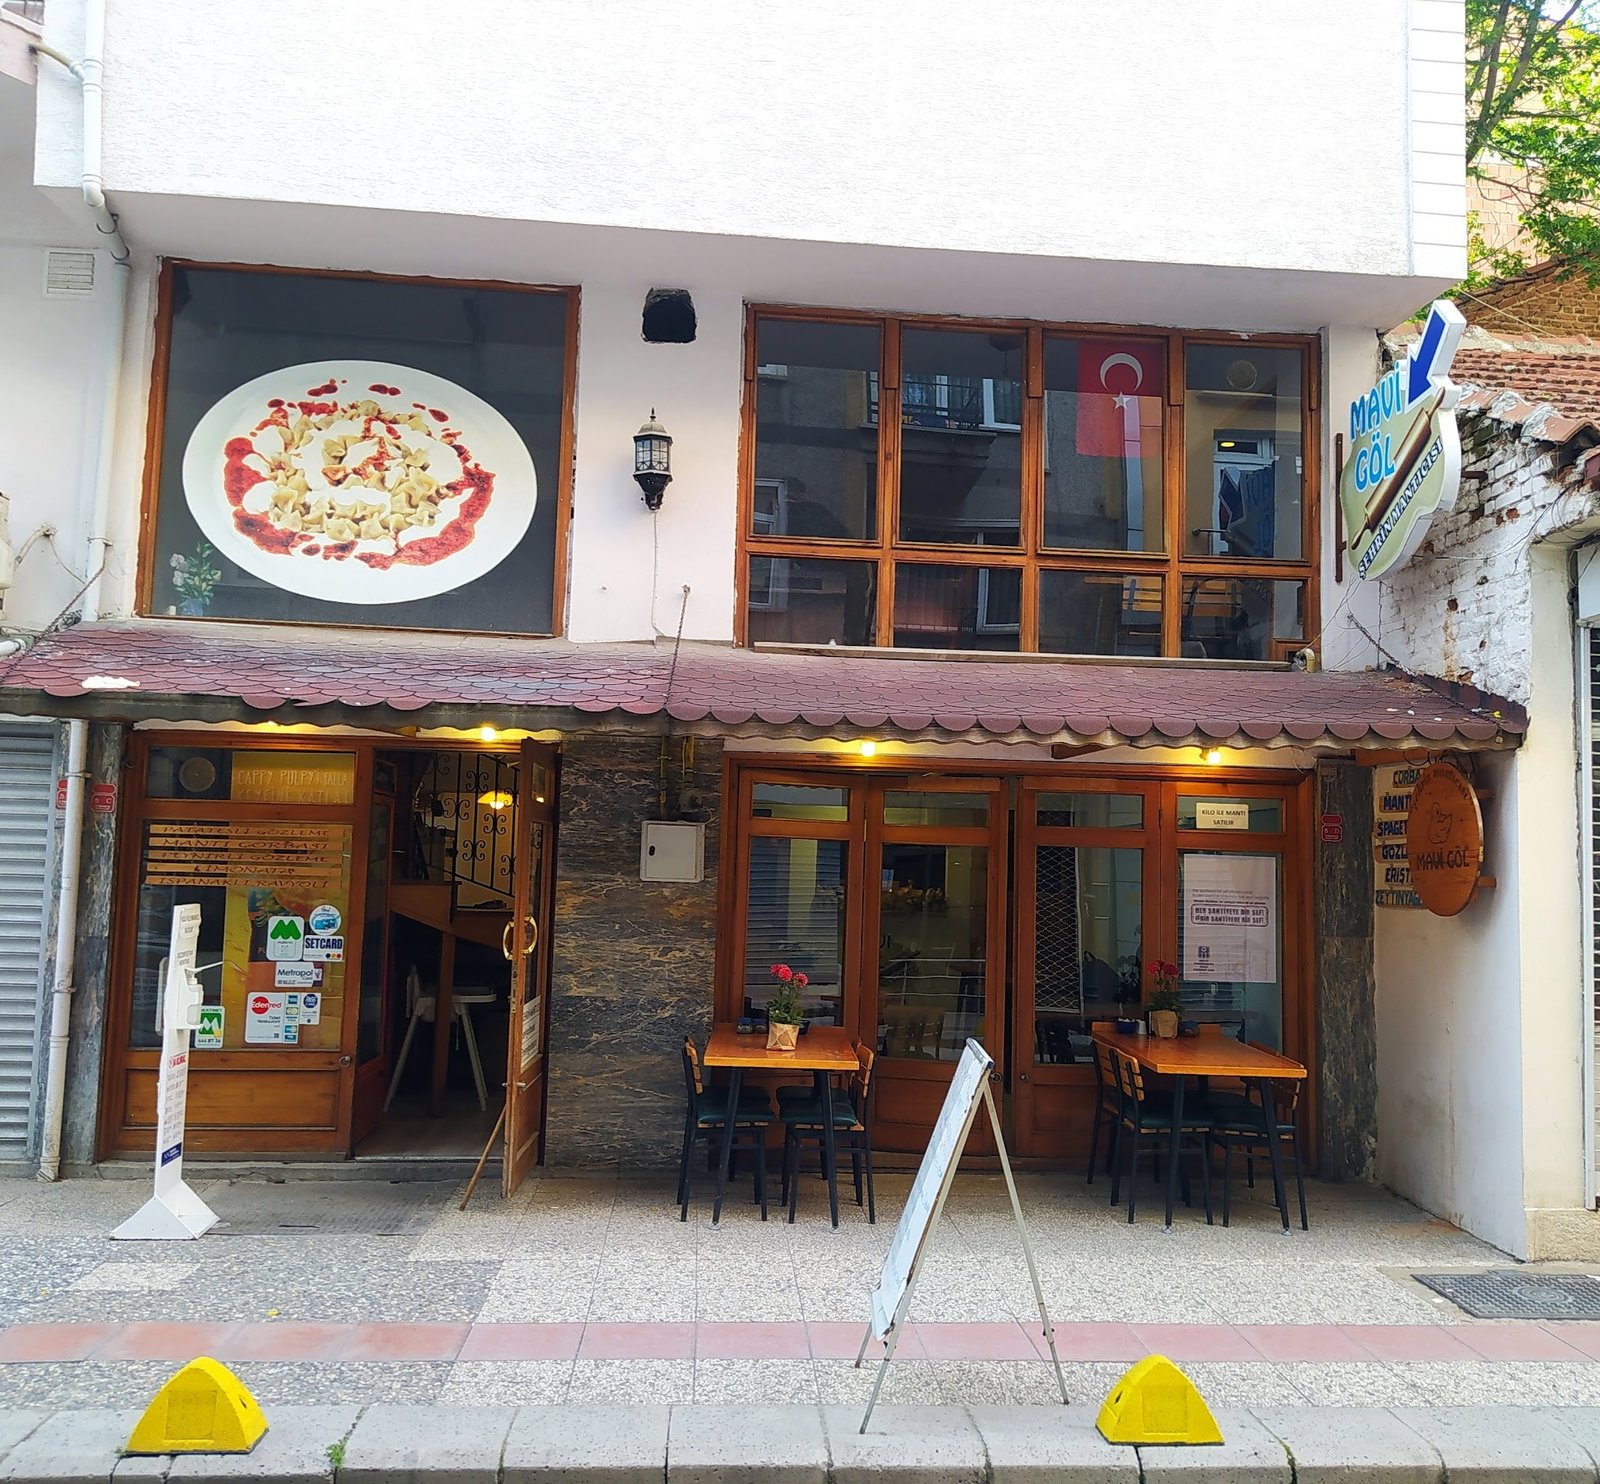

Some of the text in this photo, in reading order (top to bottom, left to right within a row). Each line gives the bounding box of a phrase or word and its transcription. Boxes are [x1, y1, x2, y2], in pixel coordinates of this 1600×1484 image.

[1350, 360, 1402, 441] MAVİ
[1355, 430, 1396, 491] GÖL
[1358, 435, 1444, 581] ŞEHRİN MANTICISI
[1383, 794, 1411, 811] MANT
[1377, 820, 1408, 837] SPAGET
[1447, 845, 1470, 868] GÖL
[1385, 867, 1413, 884] ERİŞT
[305, 937, 343, 949] SETCARD
[277, 969, 314, 980] Metropol
[251, 1001, 282, 1009] Edenred
